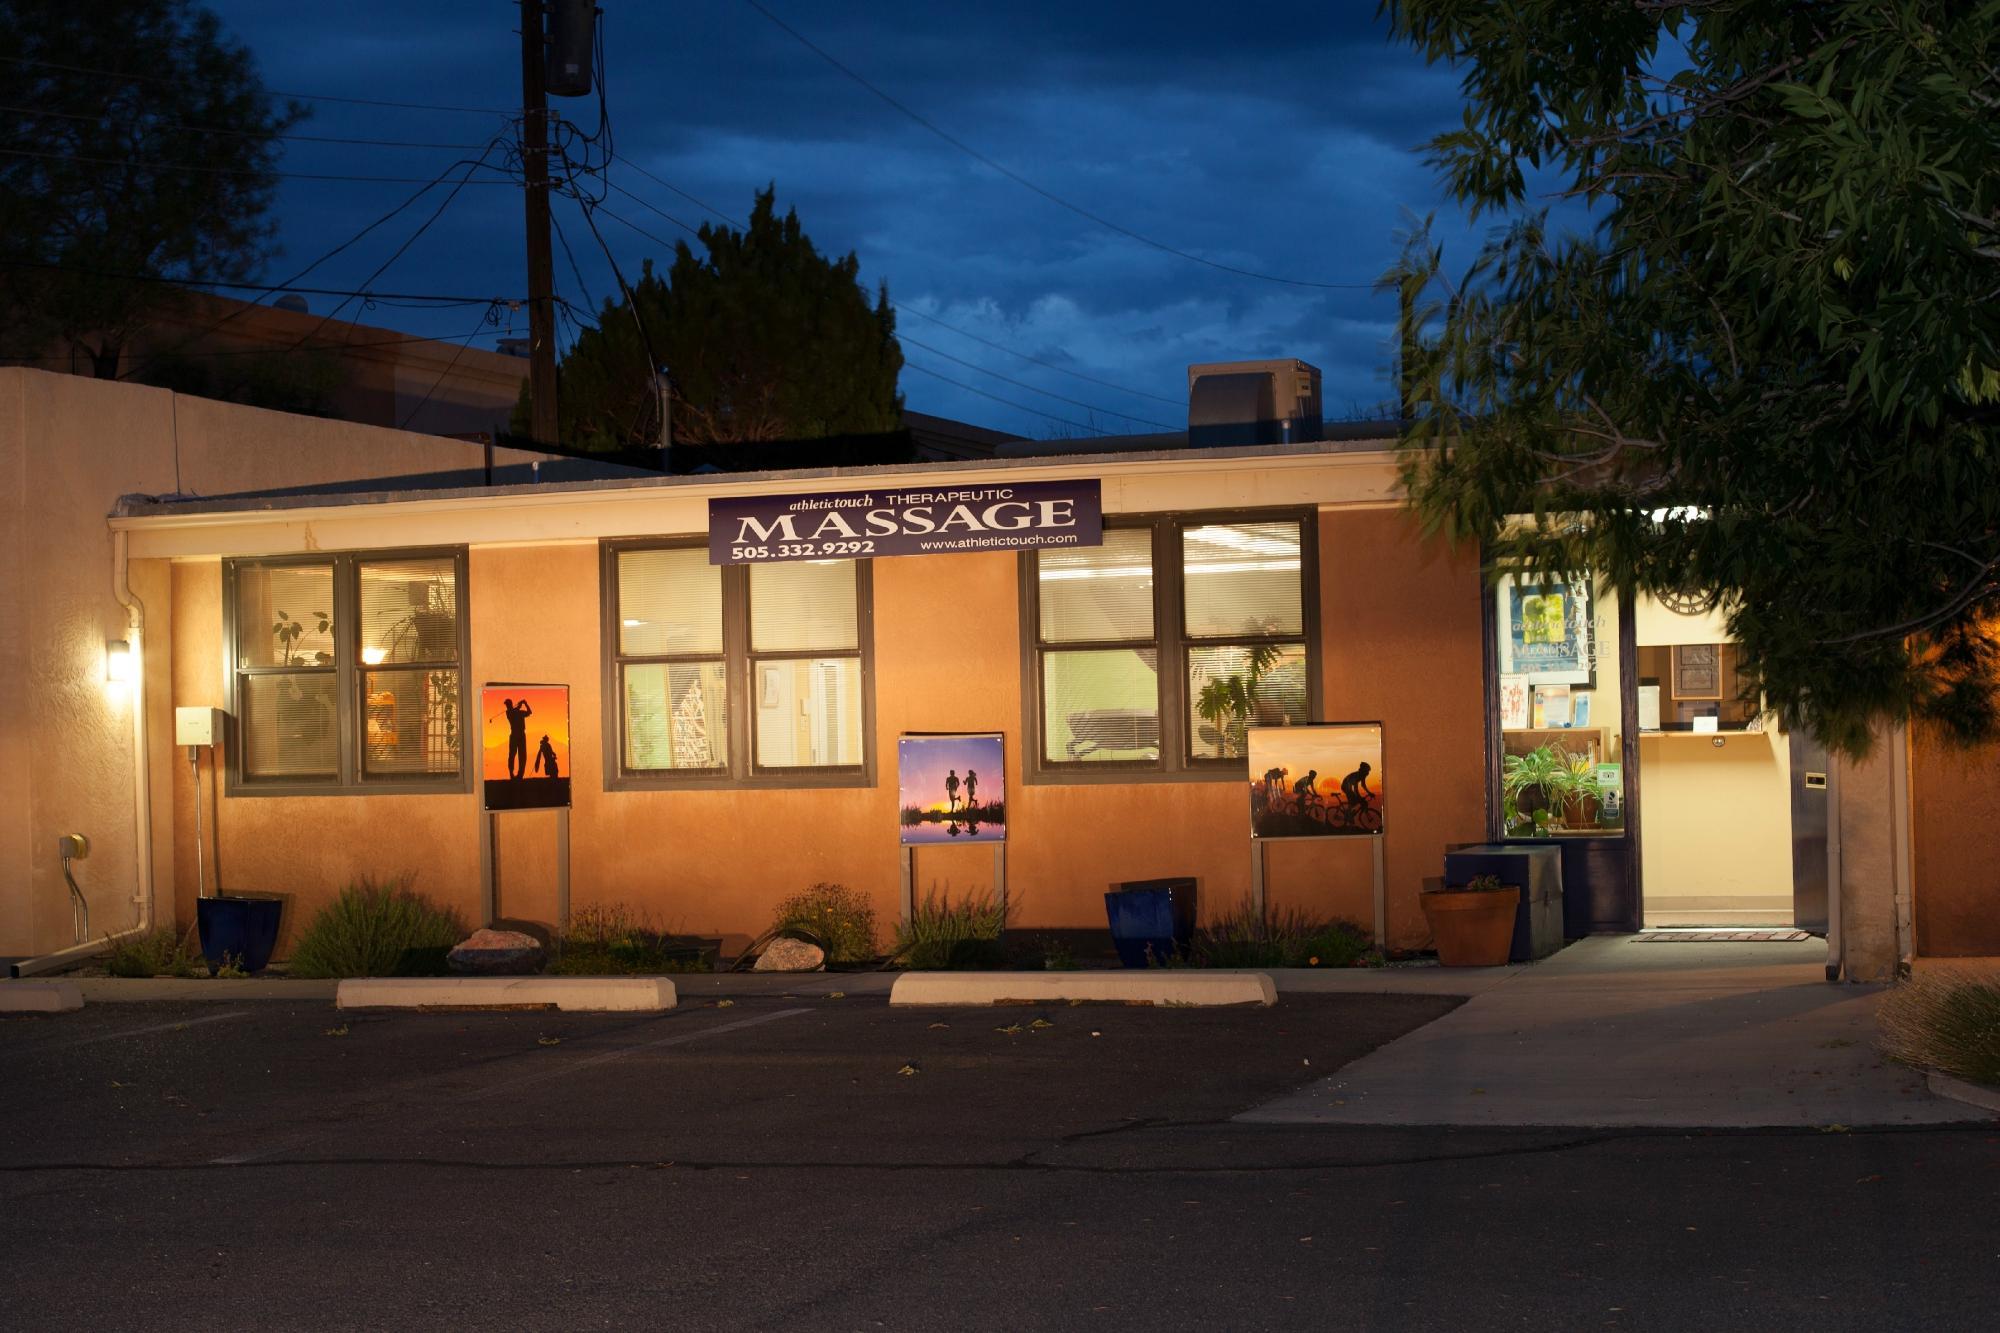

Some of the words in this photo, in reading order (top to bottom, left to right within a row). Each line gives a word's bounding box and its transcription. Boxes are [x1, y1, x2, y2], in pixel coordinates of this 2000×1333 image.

[789, 494, 873, 511] athletictouch
[886, 489, 1013, 505] THERAPEUTIC
[730, 499, 1076, 543] MASSAGE
[731, 541, 875, 560] 505.332.9292
[920, 534, 1077, 550] www.athletictouch.com
